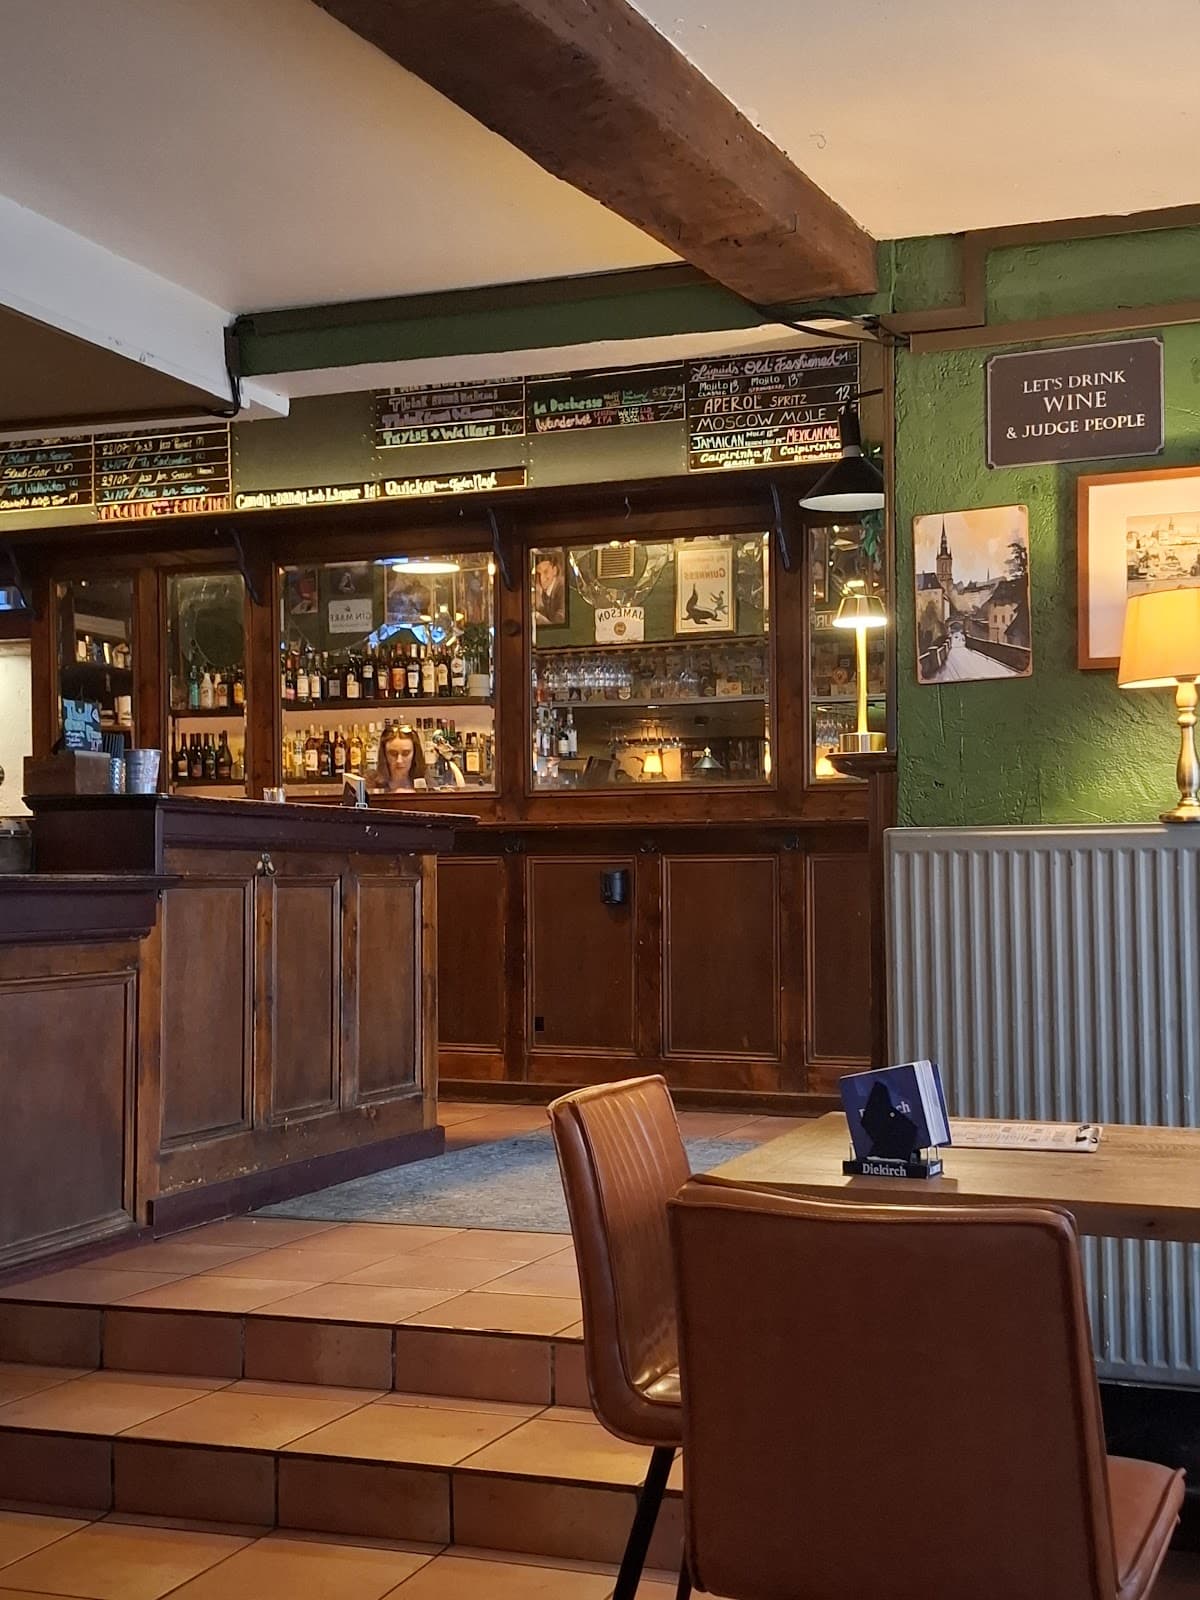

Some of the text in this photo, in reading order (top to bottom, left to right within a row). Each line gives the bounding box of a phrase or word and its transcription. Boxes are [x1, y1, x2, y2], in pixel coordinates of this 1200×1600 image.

[744, 357, 772, 375] Old
[700, 380, 729, 391] Mojito
[751, 375, 780, 387] Mojito
[1023, 370, 1126, 393] LET'S DRINK
[704, 395, 762, 413] APEROL
[769, 394, 807, 408] SPRITZ
[1044, 390, 1107, 413] WINE
[696, 412, 774, 432] MOSCOW
[779, 407, 827, 424] MULE
[1006, 413, 1145, 440] & JUDGE PEOPLE
[692, 434, 745, 449] JAMAICAN
[787, 426, 823, 442] MEXICAN
[862, 1162, 907, 1177] Diekirch
